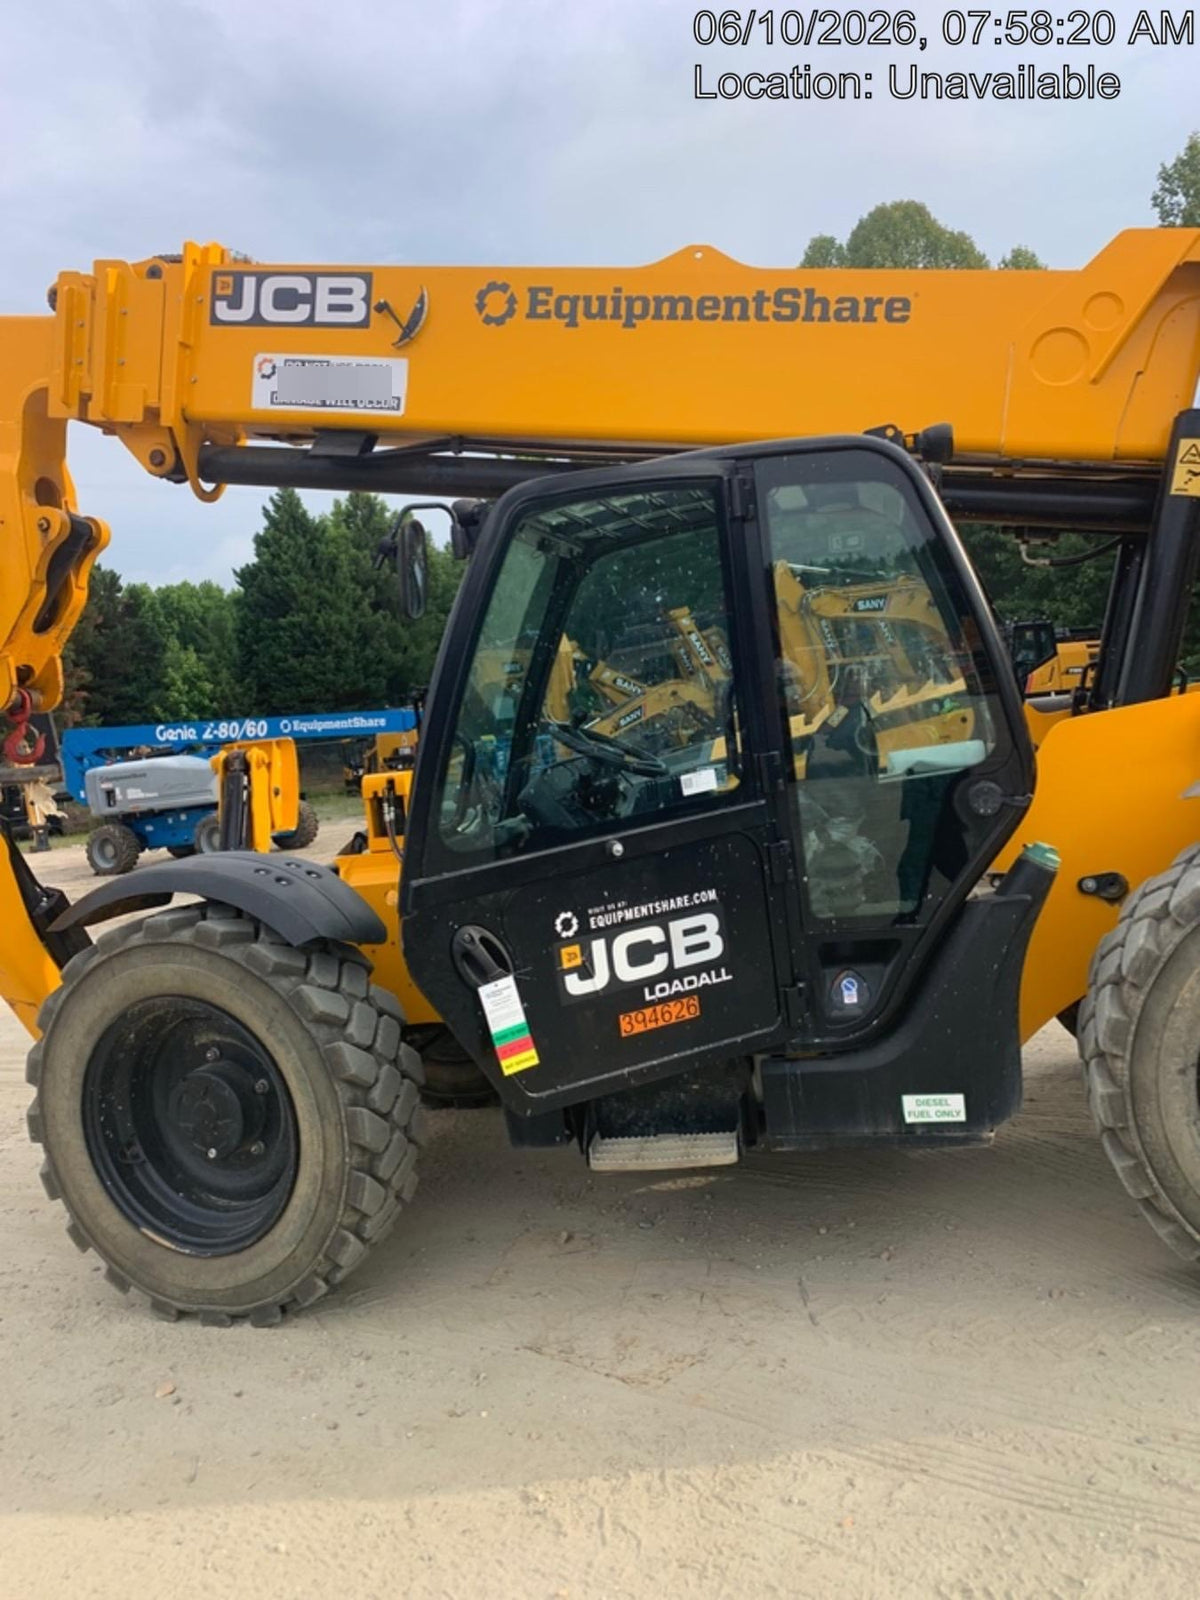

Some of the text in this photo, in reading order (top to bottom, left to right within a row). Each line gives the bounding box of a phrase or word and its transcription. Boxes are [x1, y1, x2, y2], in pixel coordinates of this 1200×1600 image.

[214, 276, 367, 322] JCB
[525, 286, 912, 329] EquipmentShare
[857, 598, 885, 611] SANY
[688, 632, 714, 667] SANY
[615, 677, 642, 695] SANY
[155, 720, 268, 742] Genie Z-80/60
[292, 716, 387, 733] EquipmentShare
[619, 707, 643, 727] SANY
[589, 888, 718, 929] EQUIPMENTSHARE.COM
[564, 912, 724, 996] JCB
[644, 967, 733, 1002] LOADALL
[621, 997, 699, 1035] 394626
[908, 1109, 961, 1118] FUEL ONLY
[915, 1097, 951, 1107] DIESEL
